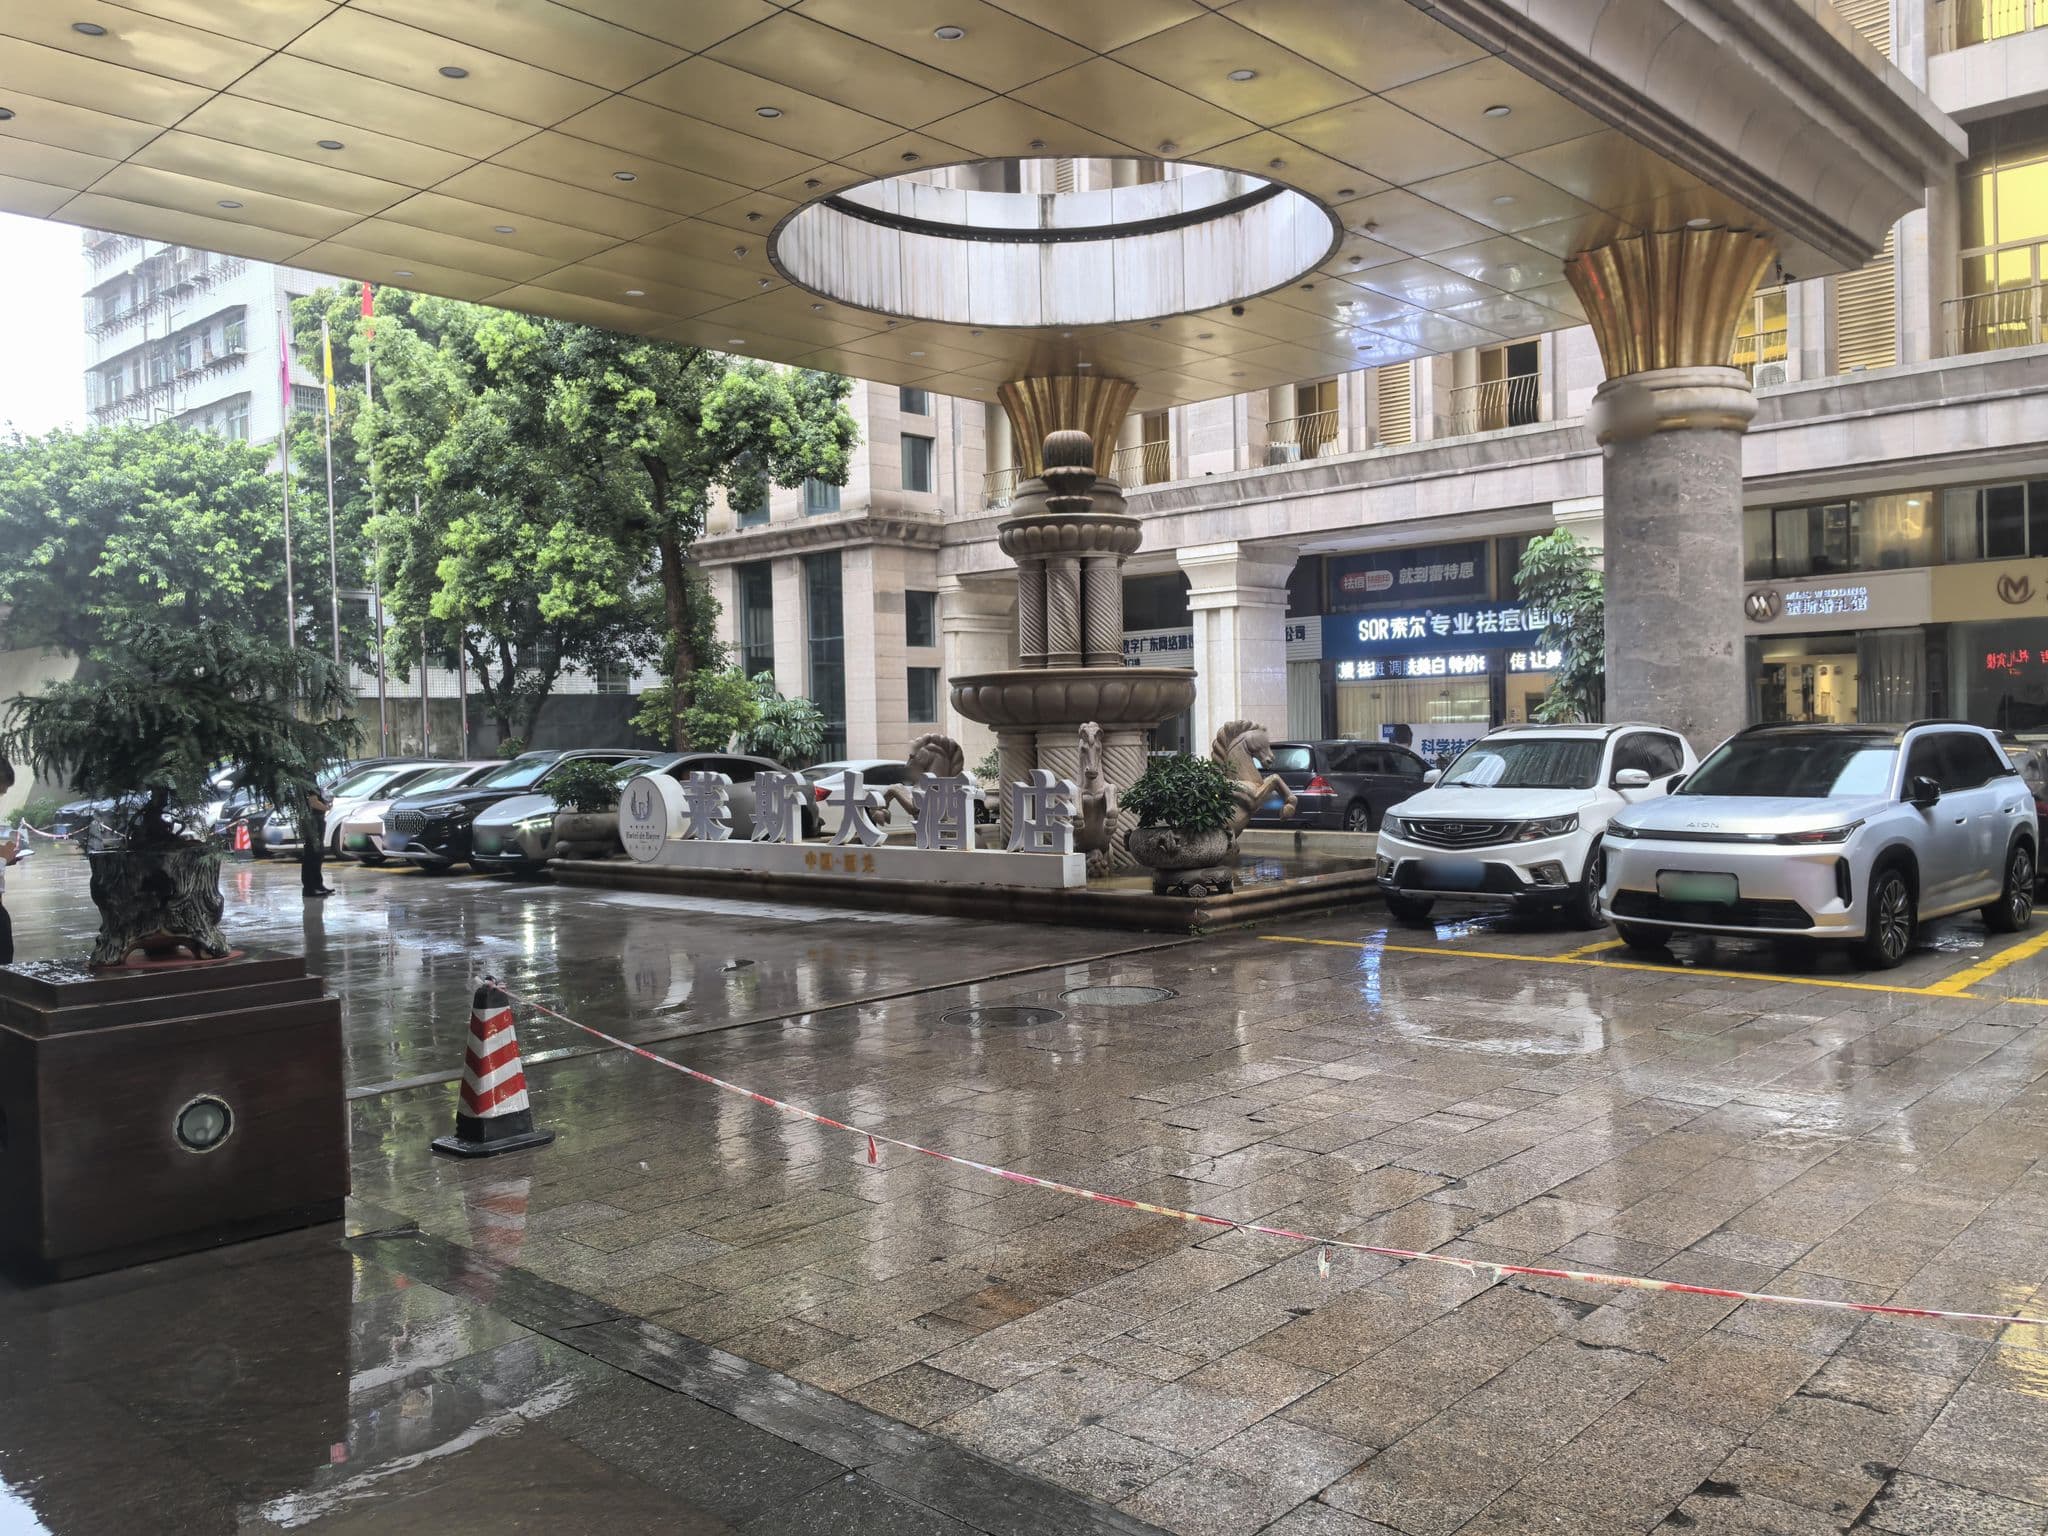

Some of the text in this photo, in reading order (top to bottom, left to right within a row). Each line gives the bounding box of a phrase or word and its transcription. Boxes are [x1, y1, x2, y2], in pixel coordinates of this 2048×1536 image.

[1285, 625, 1306, 642] 公司
[1358, 615, 1427, 642] SOR索尔
[681, 769, 1083, 856] 莱斯大酒店
[1686, 821, 1720, 829] AION
